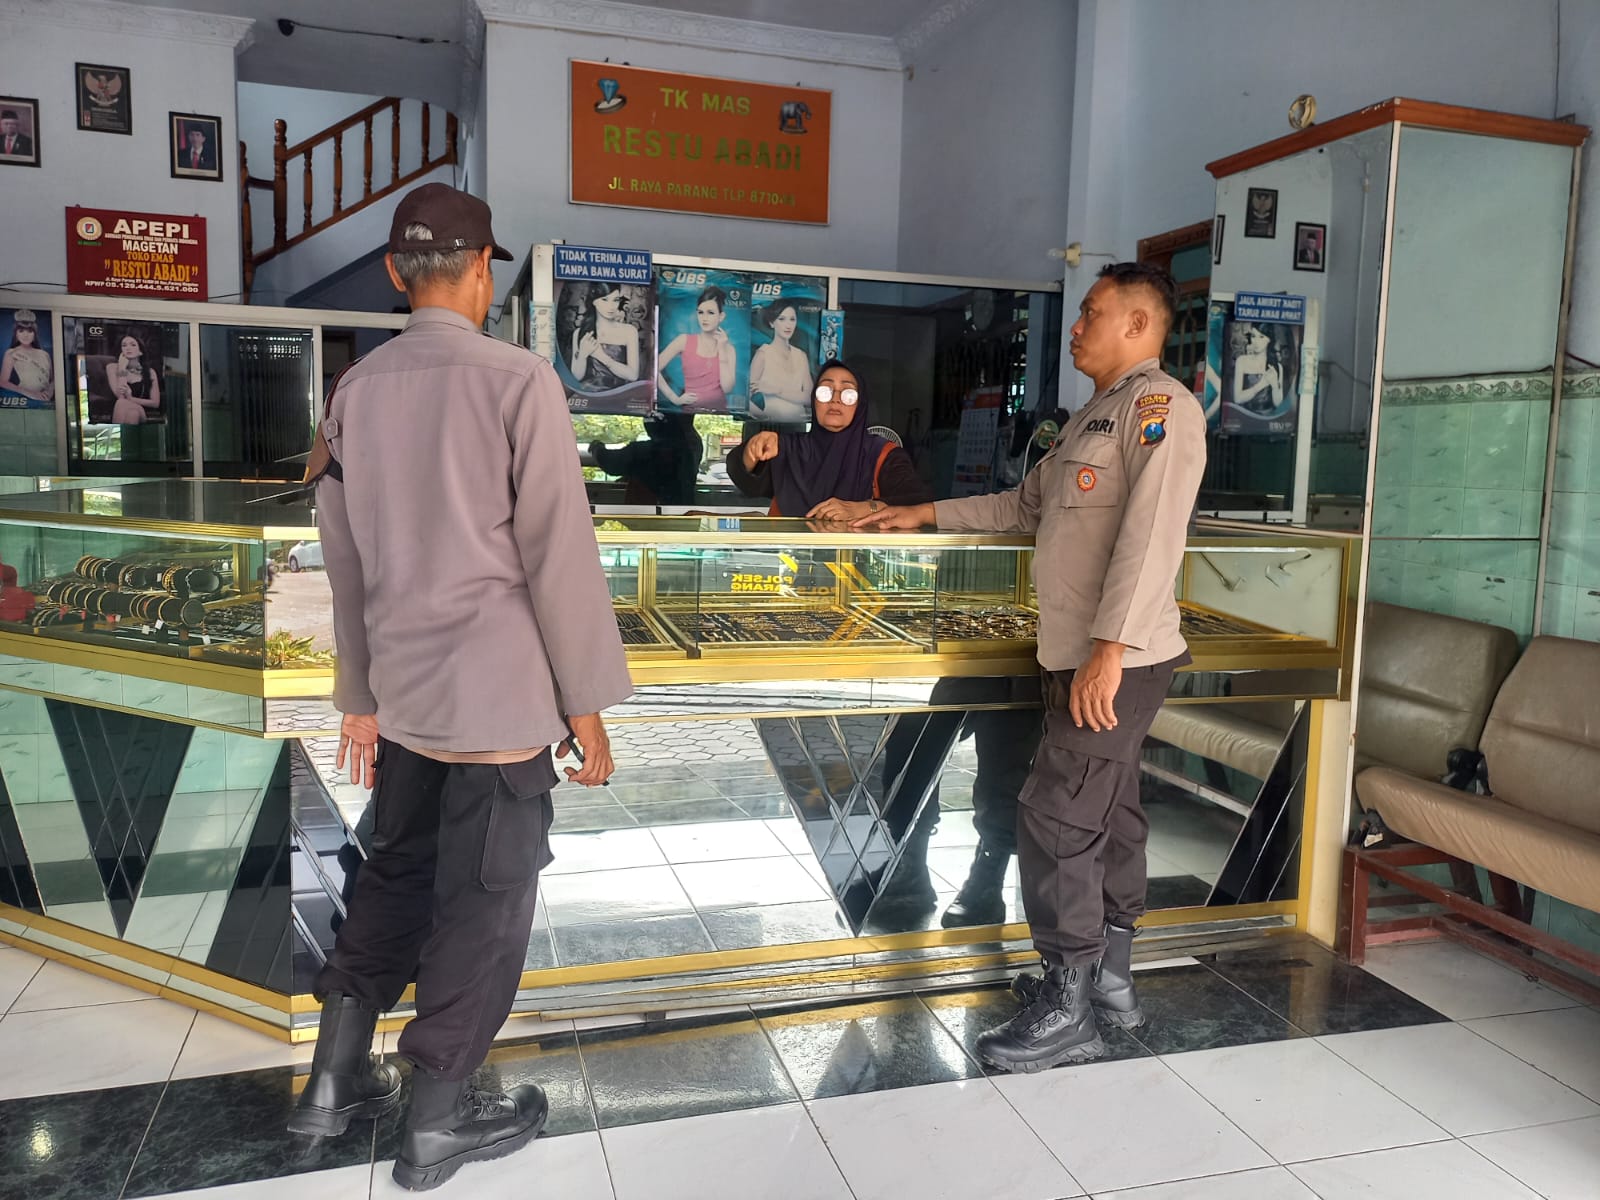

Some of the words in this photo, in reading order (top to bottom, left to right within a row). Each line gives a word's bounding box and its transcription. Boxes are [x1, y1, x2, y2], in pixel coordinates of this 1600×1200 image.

[660, 87, 689, 110] TK
[702, 92, 751, 116] MAS
[603, 124, 703, 162] RESTU
[714, 136, 801, 172] ABADI
[608, 176, 624, 191] JL
[630, 178, 662, 194] RAYA
[667, 182, 718, 200] PARANG
[113, 218, 190, 239] APEPI
[122, 240, 179, 255] MAGETAN
[127, 251, 150, 262] TOKO
[151, 253, 174, 264] EMAS
[559, 249, 587, 262] TIDAK
[589, 251, 622, 265] TERIMA
[624, 254, 648, 266] JUAL
[559, 263, 589, 276] TANPA
[591, 265, 617, 278] BAWA
[618, 268, 648, 280] SURAT
[676, 271, 707, 285] UBS
[752, 282, 782, 296] UBS
[2, 396, 28, 406] UBS
[567, 398, 589, 408] UBS
